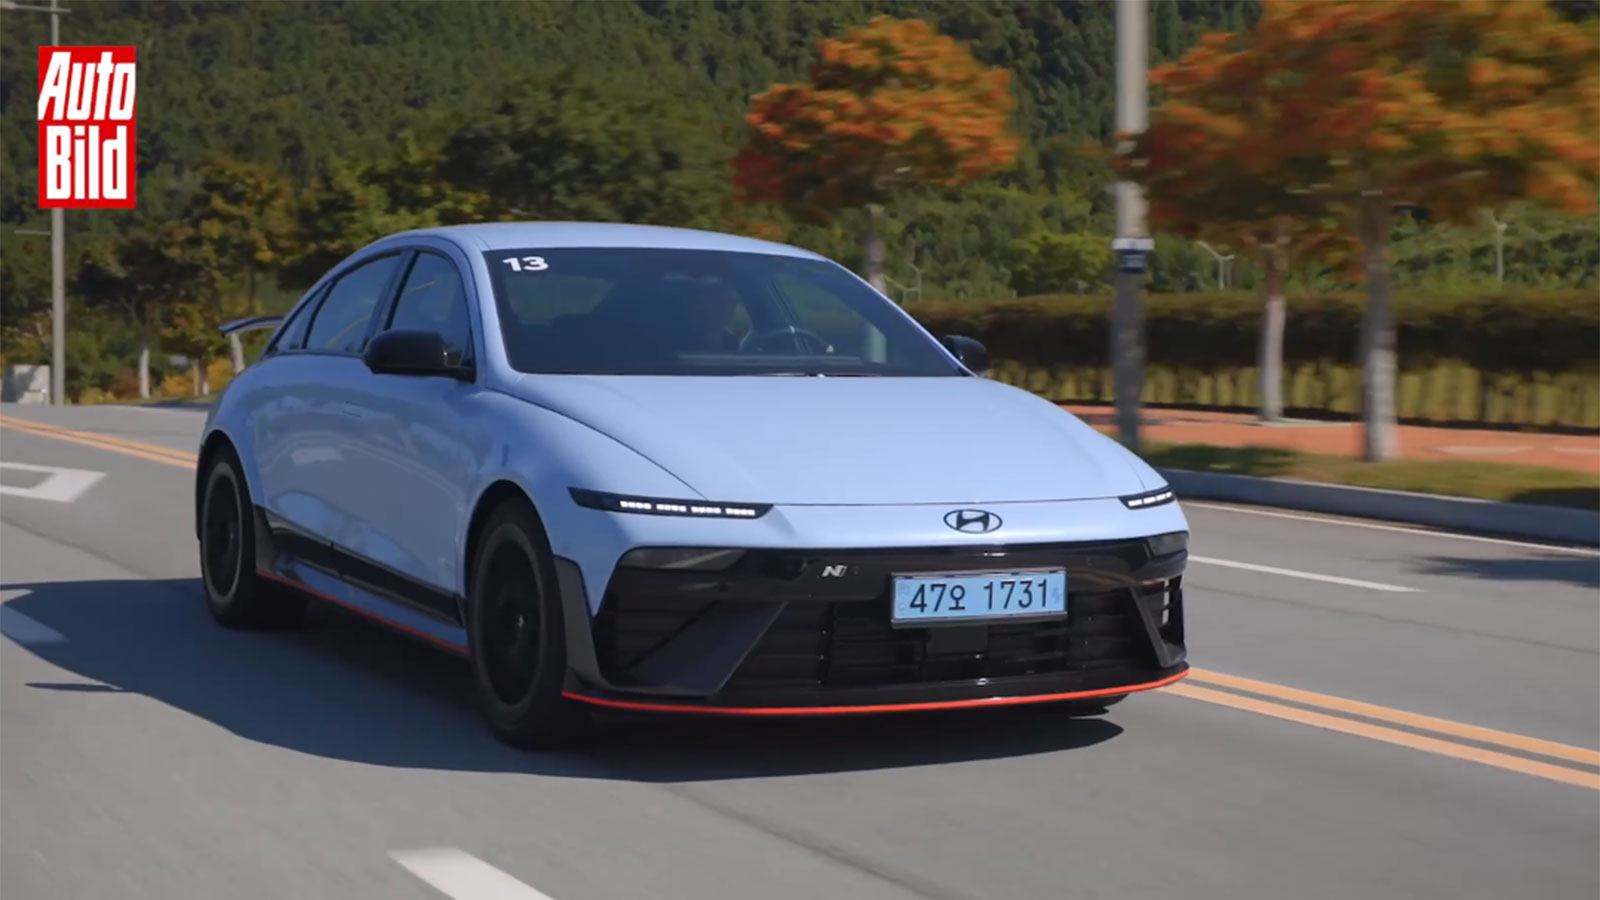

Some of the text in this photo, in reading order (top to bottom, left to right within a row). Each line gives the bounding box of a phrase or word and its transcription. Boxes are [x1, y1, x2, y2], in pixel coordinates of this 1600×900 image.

[502, 256, 549, 272] 13
[909, 579, 1048, 613] 47오 1731
